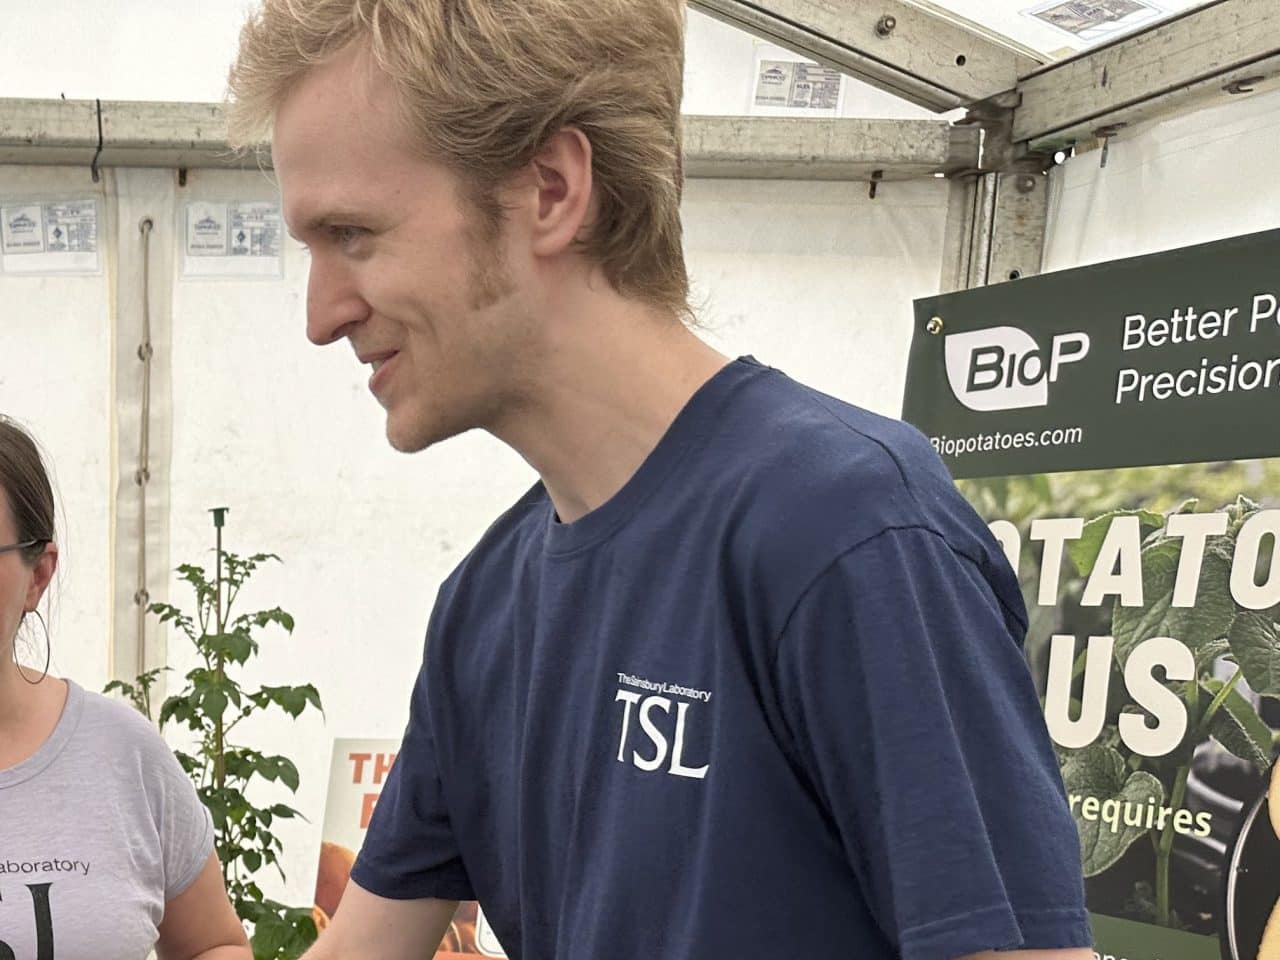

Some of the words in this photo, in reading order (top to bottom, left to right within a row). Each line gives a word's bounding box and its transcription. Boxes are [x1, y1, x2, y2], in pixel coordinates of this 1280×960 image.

[1121, 306, 1239, 351] Better
[617, 672, 712, 702] TheSainsburyLaboratory
[615, 689, 710, 779] TSL
[1068, 793, 1213, 837] requires
